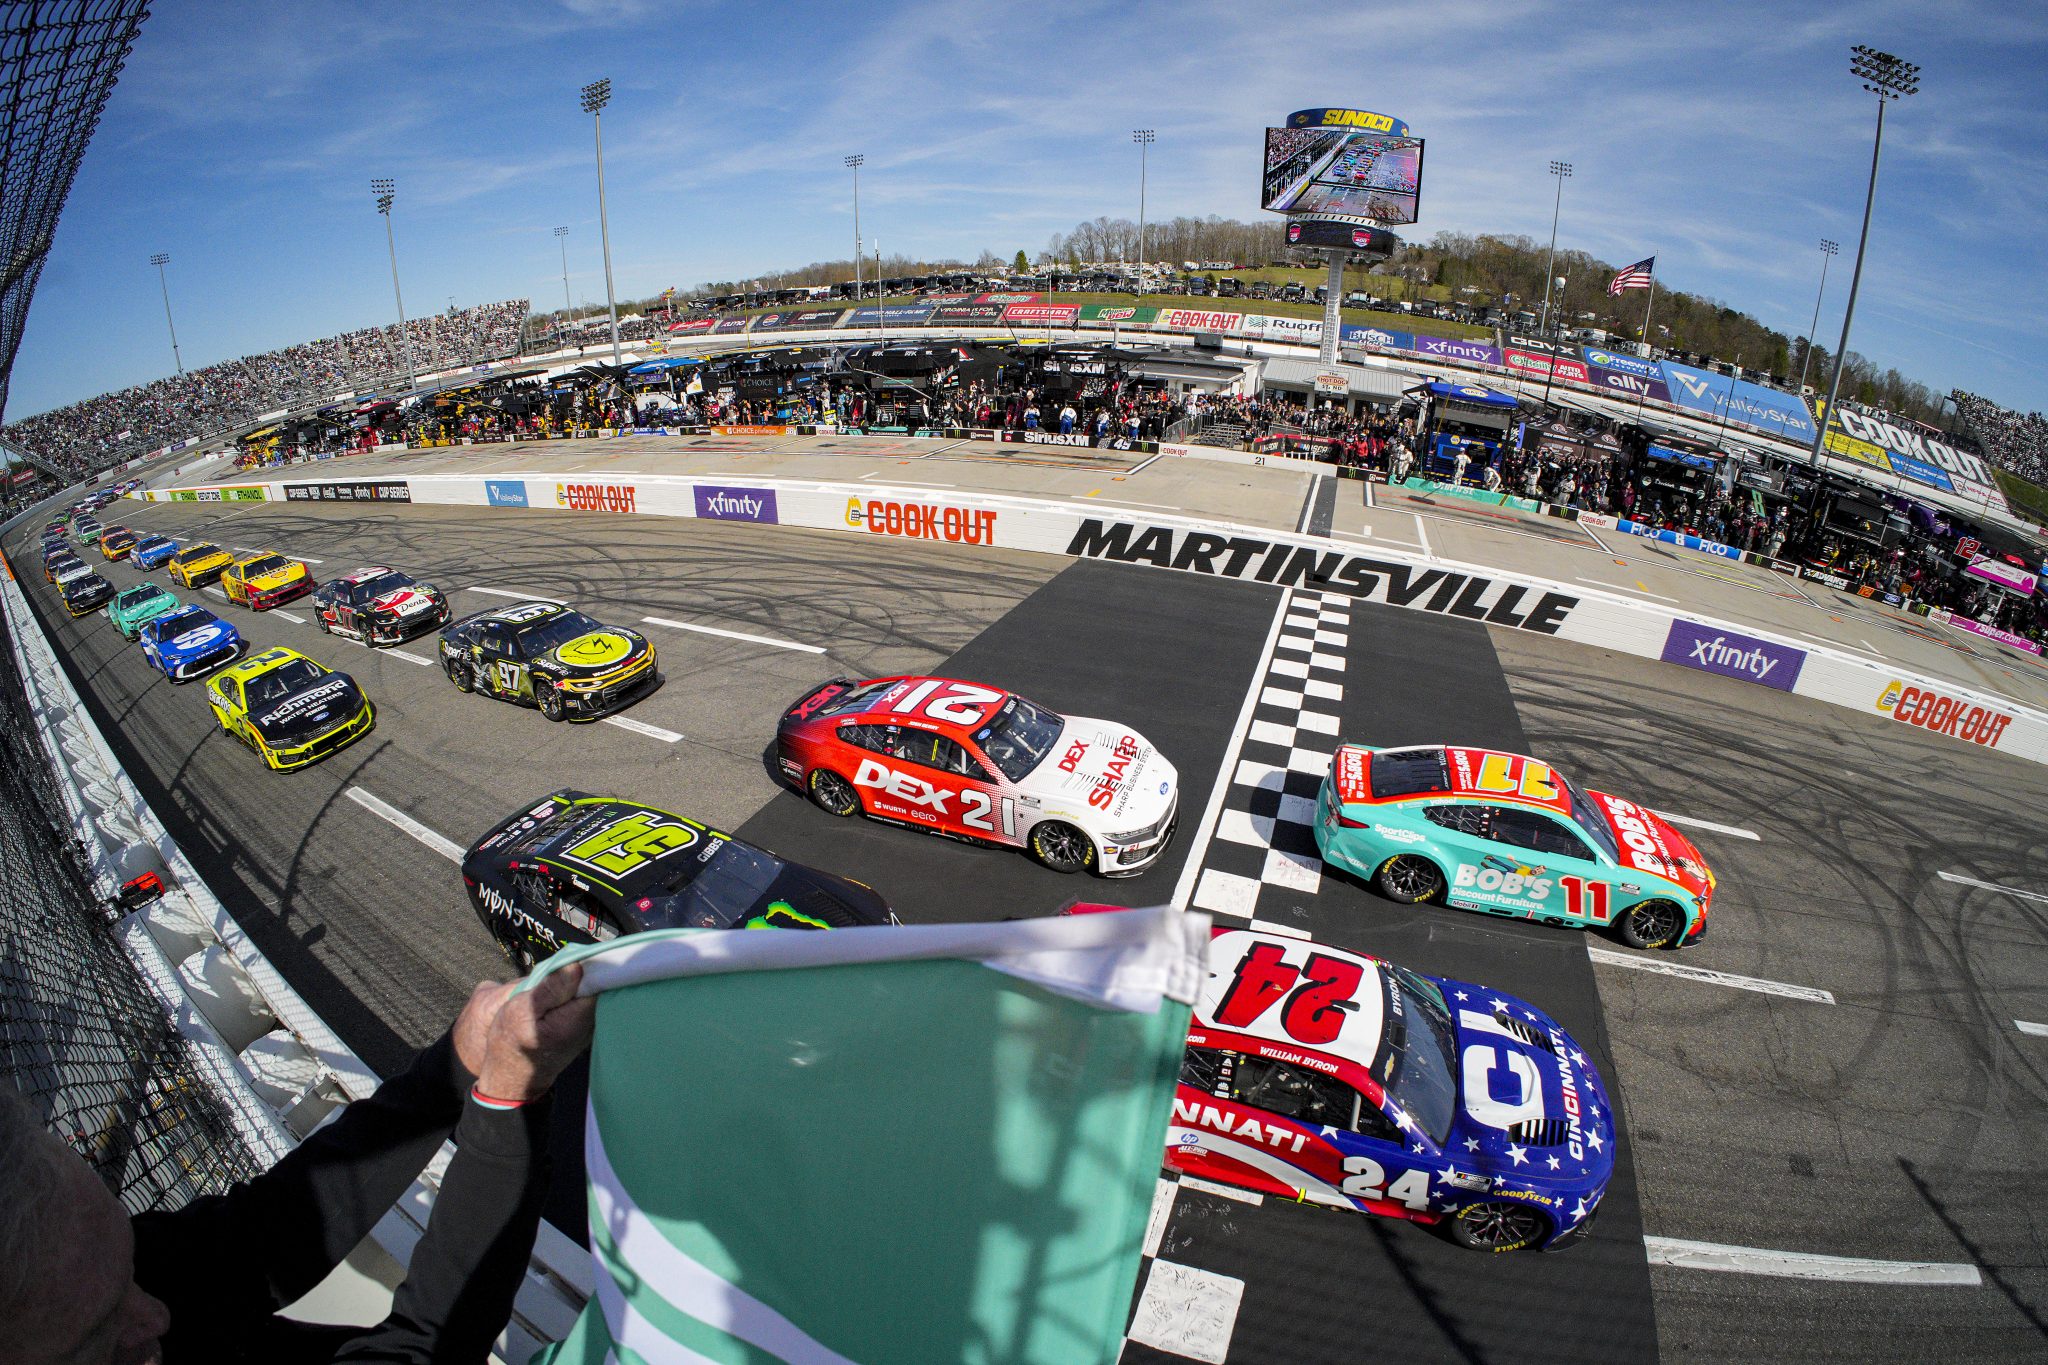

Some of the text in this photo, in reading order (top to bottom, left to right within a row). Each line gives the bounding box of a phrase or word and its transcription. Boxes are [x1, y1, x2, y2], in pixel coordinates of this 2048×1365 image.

[1322, 110, 1394, 131] SUNOCO
[1170, 312, 1239, 330] COOK OUT
[1273, 319, 1323, 331] Ruoff
[1351, 332, 1393, 344] BUSCH
[1510, 336, 1576, 356] GOVX
[1426, 341, 1492, 361] xfinity
[1557, 370, 1585, 379] PARTS
[1559, 365, 1581, 373] AUTO
[1607, 375, 1650, 396] ally
[1709, 391, 1807, 430] ValleyStar
[1024, 432, 1089, 447] SiriusXM
[1113, 439, 1131, 450] 49
[1838, 408, 1938, 467] COOK
[1928, 440, 1992, 485] OUT
[1254, 457, 1265, 465] 21
[237, 489, 262, 500] ETHANOL
[379, 486, 409, 499] CUP SERIES
[498, 493, 524, 502] ValleyStar
[567, 484, 636, 513] COOK OUT
[706, 491, 763, 519] xfinity
[867, 500, 997, 545] COOK OUT
[1630, 522, 1661, 540] FICO
[1699, 539, 1728, 556] FICO
[1954, 536, 1981, 561] 12
[1066, 518, 1580, 635] MARTINSVILLE
[1815, 571, 1849, 587] ADVANCE
[1688, 636, 1779, 679] xfinity
[498, 661, 520, 690] 97
[260, 679, 349, 727] Richmond
[279, 691, 344, 724] WATER HEATERS
[1003, 699, 1019, 715] BERRY
[1894, 686, 2013, 747] COOK OUT
[1058, 739, 1090, 774] DEX
[1088, 735, 1137, 811] SHARP
[853, 758, 956, 814] DEX
[1114, 791, 1129, 818] SHARP
[1126, 761, 1143, 791] BUSINESS
[882, 803, 907, 815] WURTH
[960, 788, 1016, 837] 21
[1430, 797, 1458, 806] yahoo!
[911, 809, 936, 822] eero
[1375, 824, 1426, 842] SportClips
[1603, 796, 1667, 877] BOB'S
[697, 838, 724, 863] GIBBS
[1454, 863, 1553, 900] BOB'S
[1451, 887, 1496, 905] Discount
[1452, 900, 1471, 908] Mobil
[1559, 876, 1612, 922] 11
[1214, 941, 1365, 1044] 24
[1388, 976, 1403, 1017] BYRON
[1260, 1046, 1338, 1073] WILLIAM BYRON
[1548, 1028, 1584, 1162] CINCINNATI
[1181, 1132, 1199, 1145] hp
[1178, 1145, 1208, 1156] ALL-PRO
[1342, 1157, 1430, 1212] 24
[1493, 1190, 1552, 1205] GOODYEAR
[1494, 1240, 1526, 1253] EAGLE
